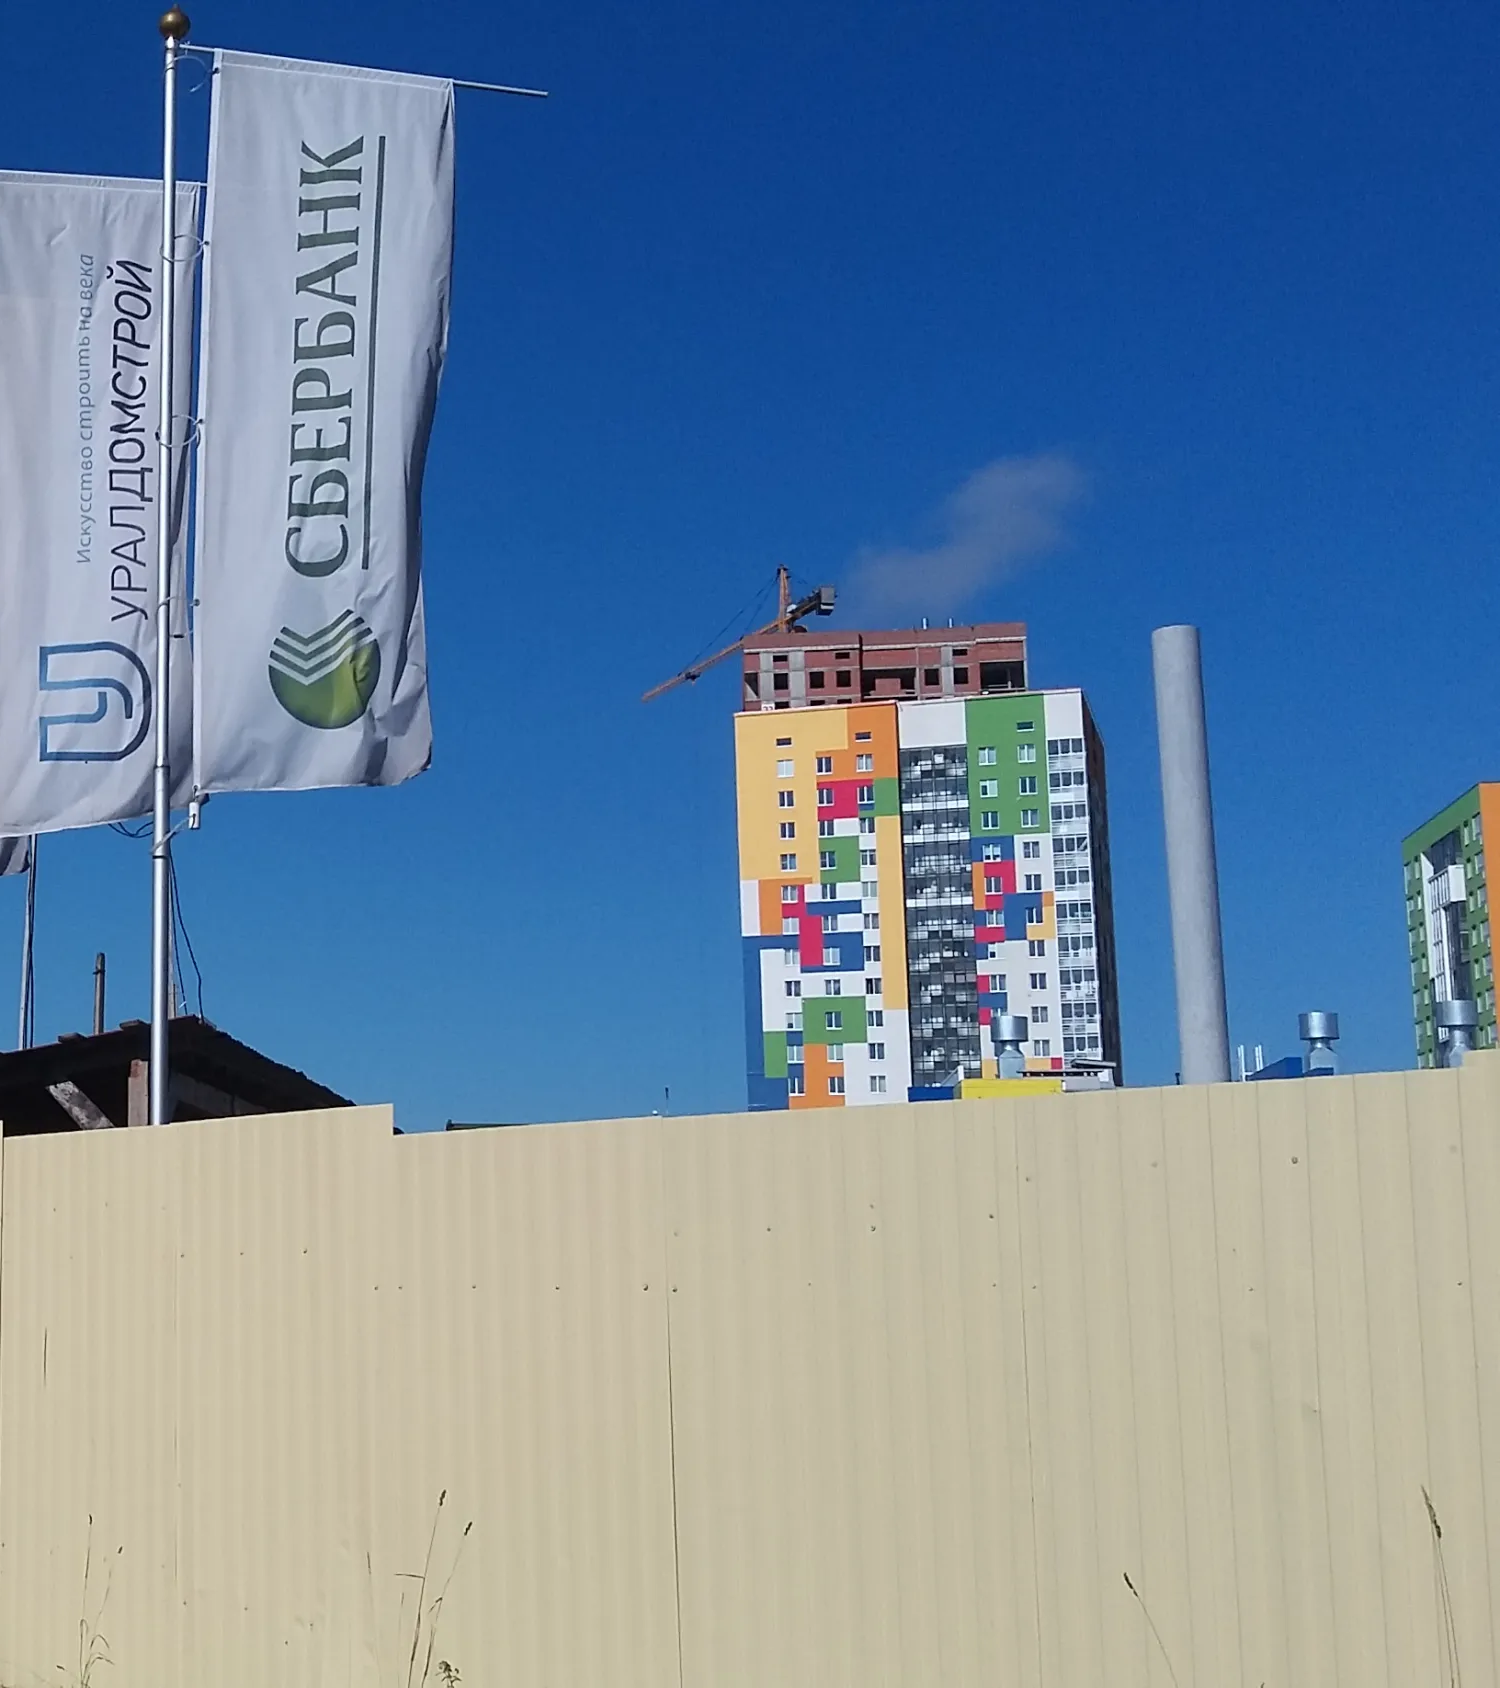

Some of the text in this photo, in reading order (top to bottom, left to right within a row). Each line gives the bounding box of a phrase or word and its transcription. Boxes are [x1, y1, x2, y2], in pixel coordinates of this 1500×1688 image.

[76, 253, 96, 564] Искусство строить на века
[106, 259, 154, 623] УРАЛДОМСТРОЙ
[285, 135, 364, 578] СБЕРБАНК
